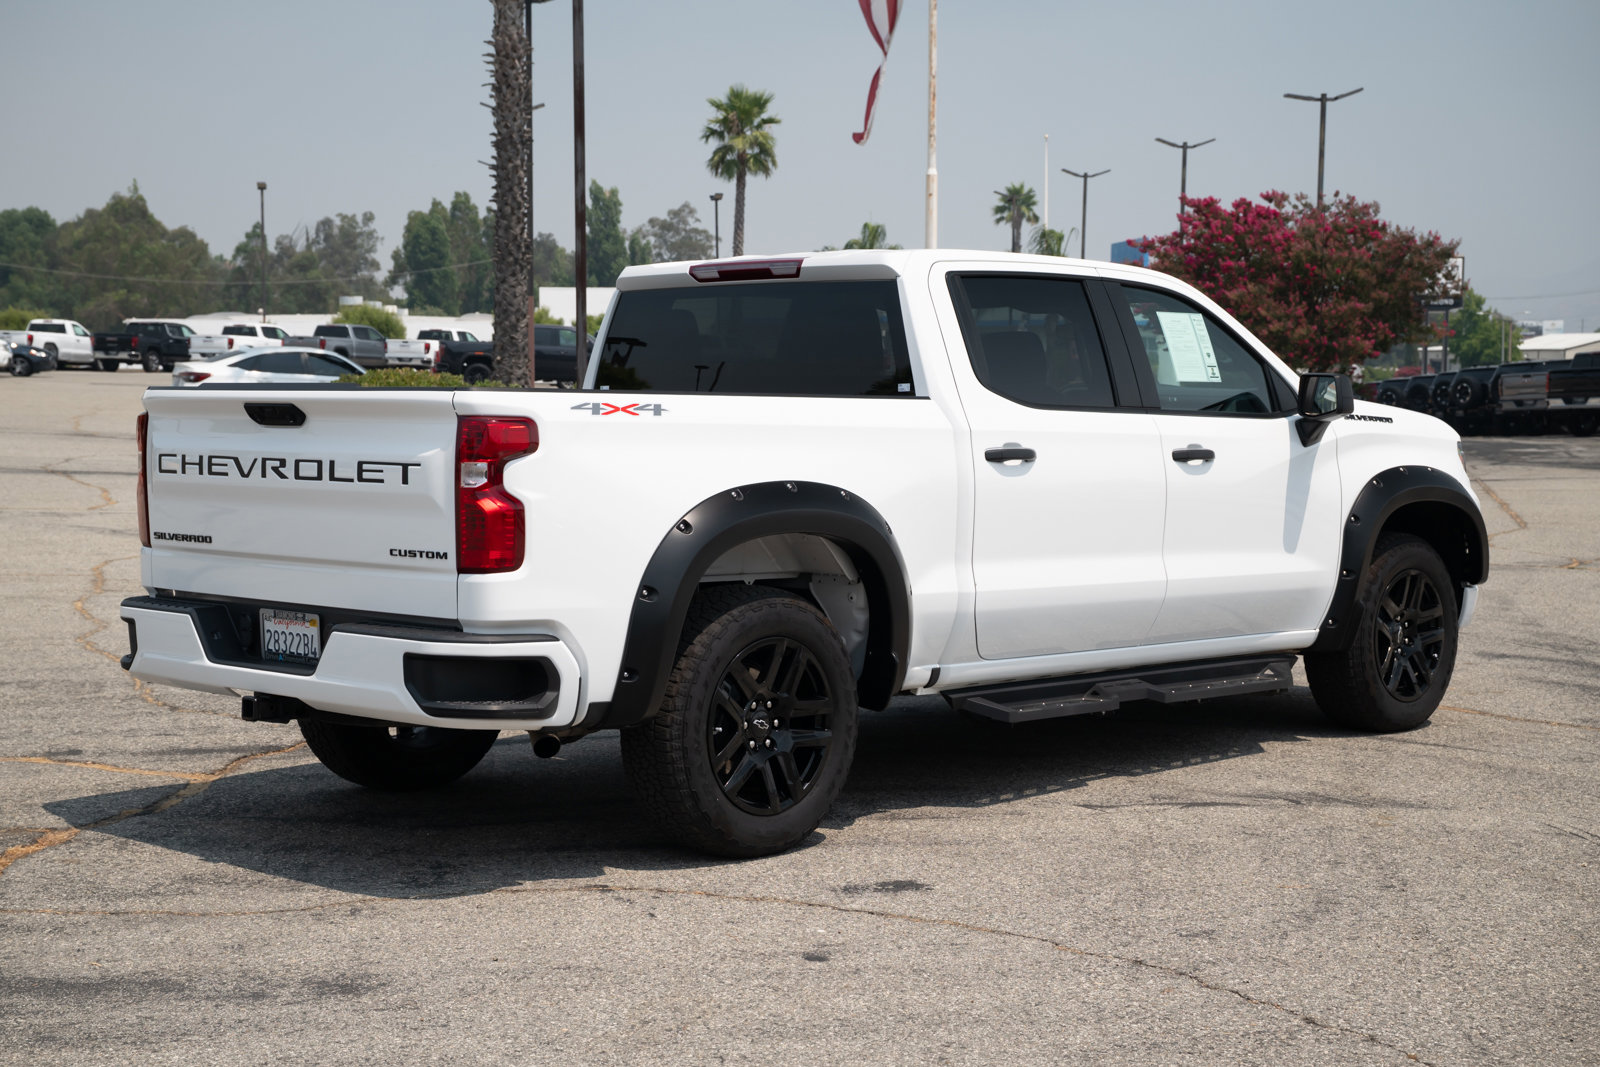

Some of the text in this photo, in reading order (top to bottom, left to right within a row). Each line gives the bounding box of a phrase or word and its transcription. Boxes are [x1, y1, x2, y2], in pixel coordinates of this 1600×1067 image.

[570, 402, 669, 416] 4X4
[158, 453, 421, 485] CHEVROLET
[153, 531, 213, 544] SILVERADO
[389, 548, 448, 560] CUSTOM
[266, 629, 317, 658] 28322B4
